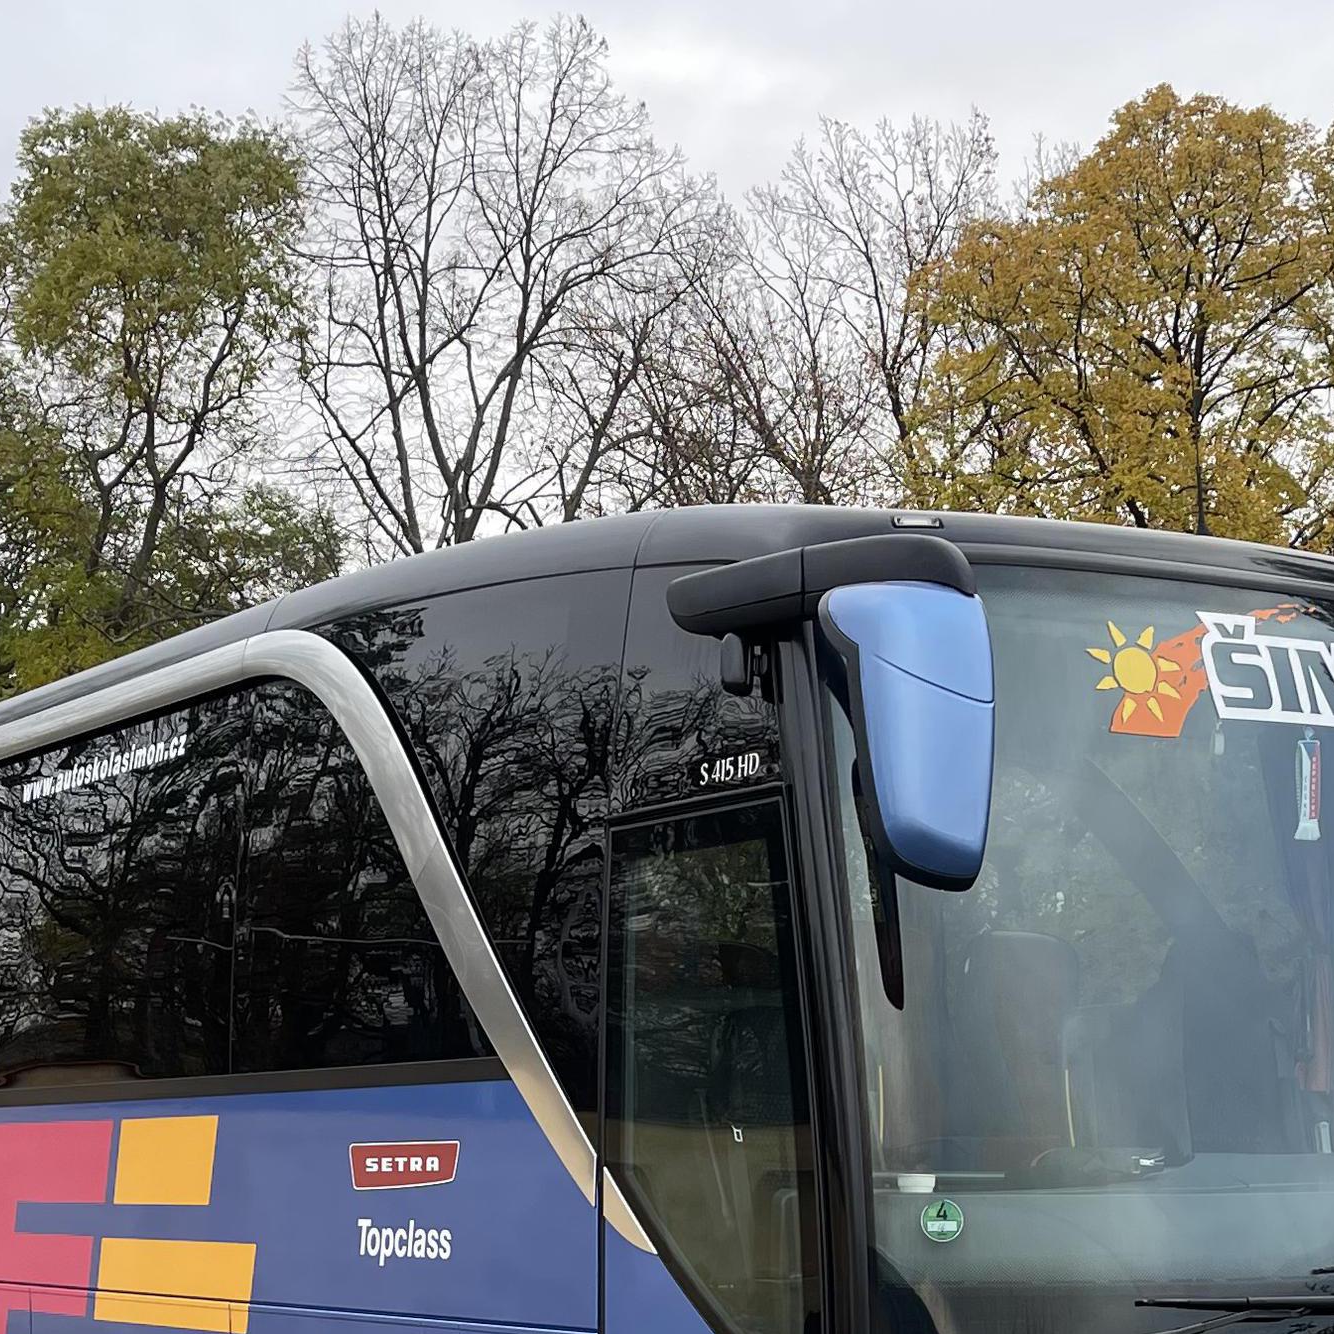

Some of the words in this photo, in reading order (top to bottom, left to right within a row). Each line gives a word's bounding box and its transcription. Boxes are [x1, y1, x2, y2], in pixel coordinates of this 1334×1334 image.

[22, 734, 187, 803] www.autoskolasimon.cz
[699, 762, 709, 786] S
[711, 757, 735, 782] 415
[737, 752, 760, 778] HD
[365, 1155, 441, 1173] SETRA
[937, 1201, 948, 1220] 4
[357, 1218, 452, 1267] Topclass
